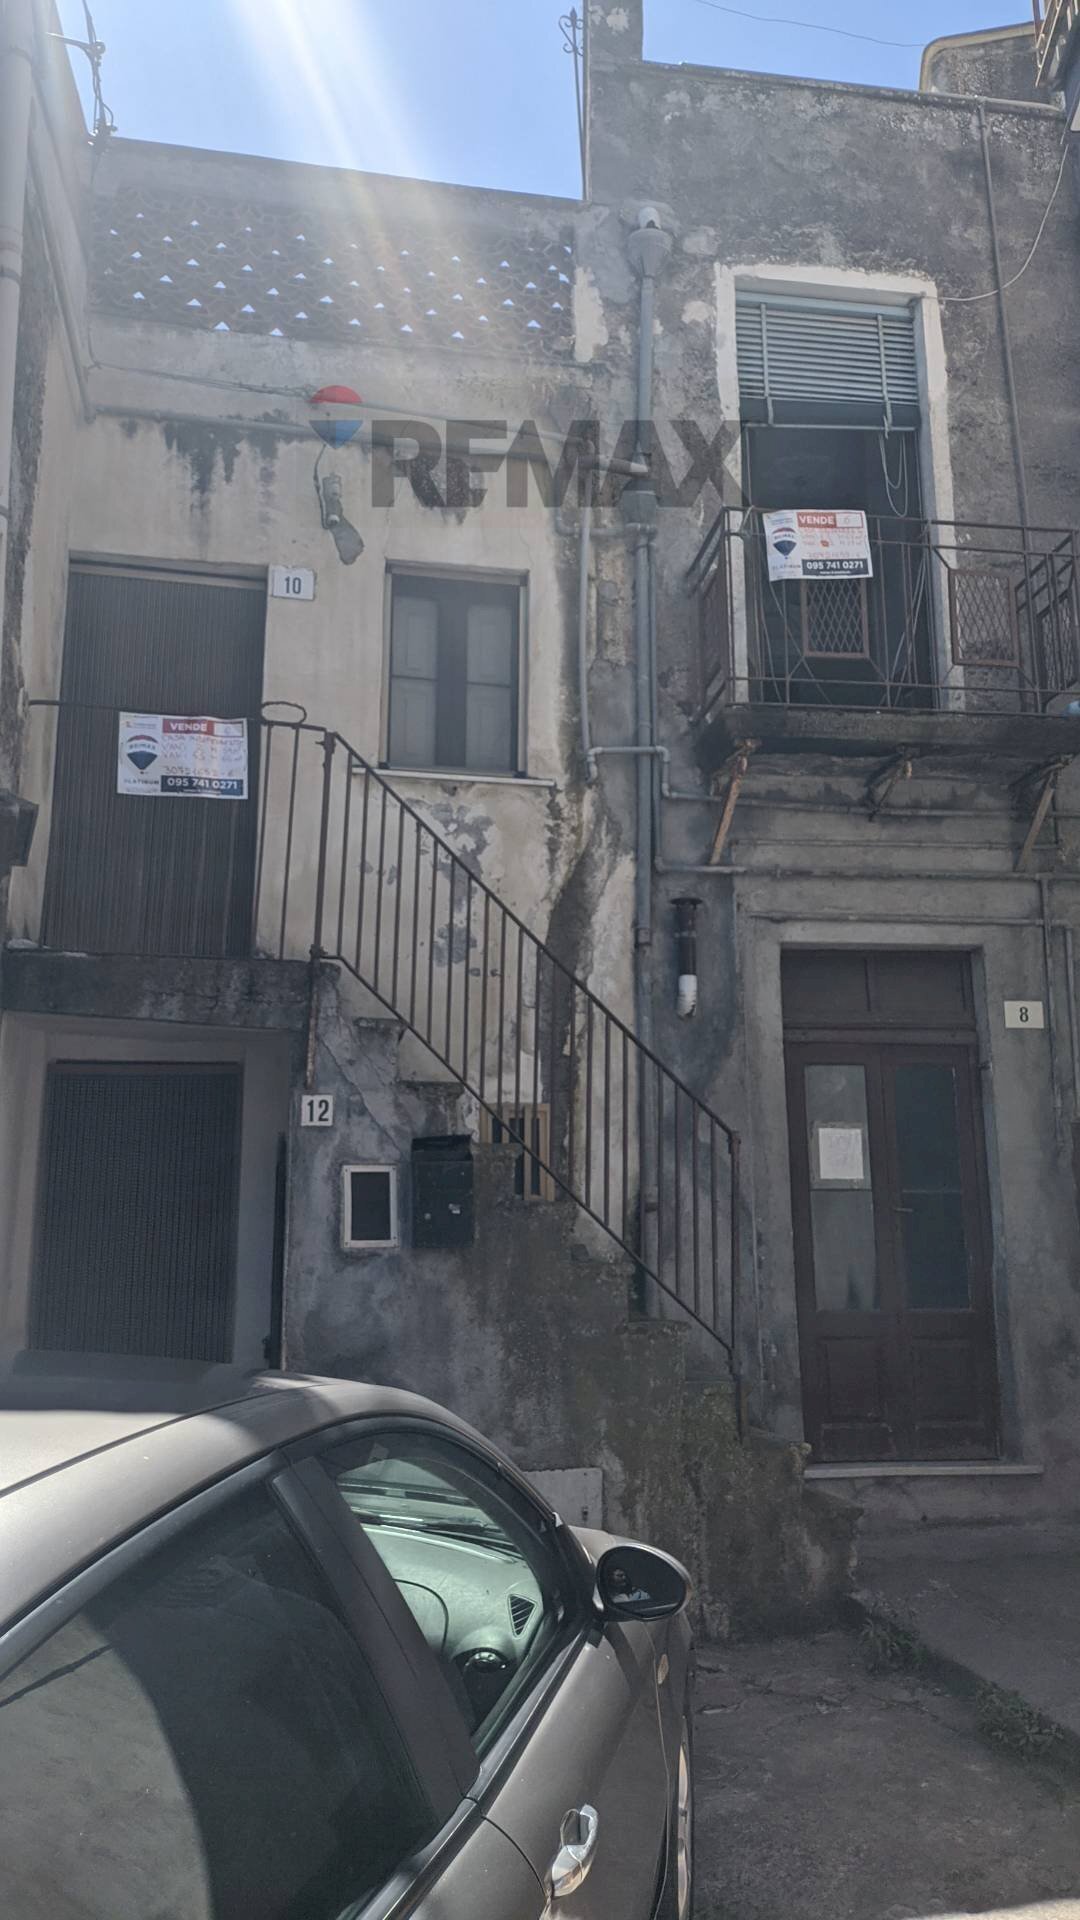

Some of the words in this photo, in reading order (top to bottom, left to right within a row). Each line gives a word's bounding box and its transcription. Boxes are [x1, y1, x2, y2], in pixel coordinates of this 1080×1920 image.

[799, 515, 834, 524] VENDE
[806, 561, 823, 570] 095
[826, 561, 840, 569] 741
[842, 560, 863, 569] 0271
[285, 576, 301, 594] 10
[169, 722, 208, 732] VENDE
[167, 777, 189, 787] 095
[192, 778, 209, 788] 741
[212, 780, 238, 790] 0271
[1019, 1006, 1029, 1023] 8
[307, 1099, 329, 1122] 12
